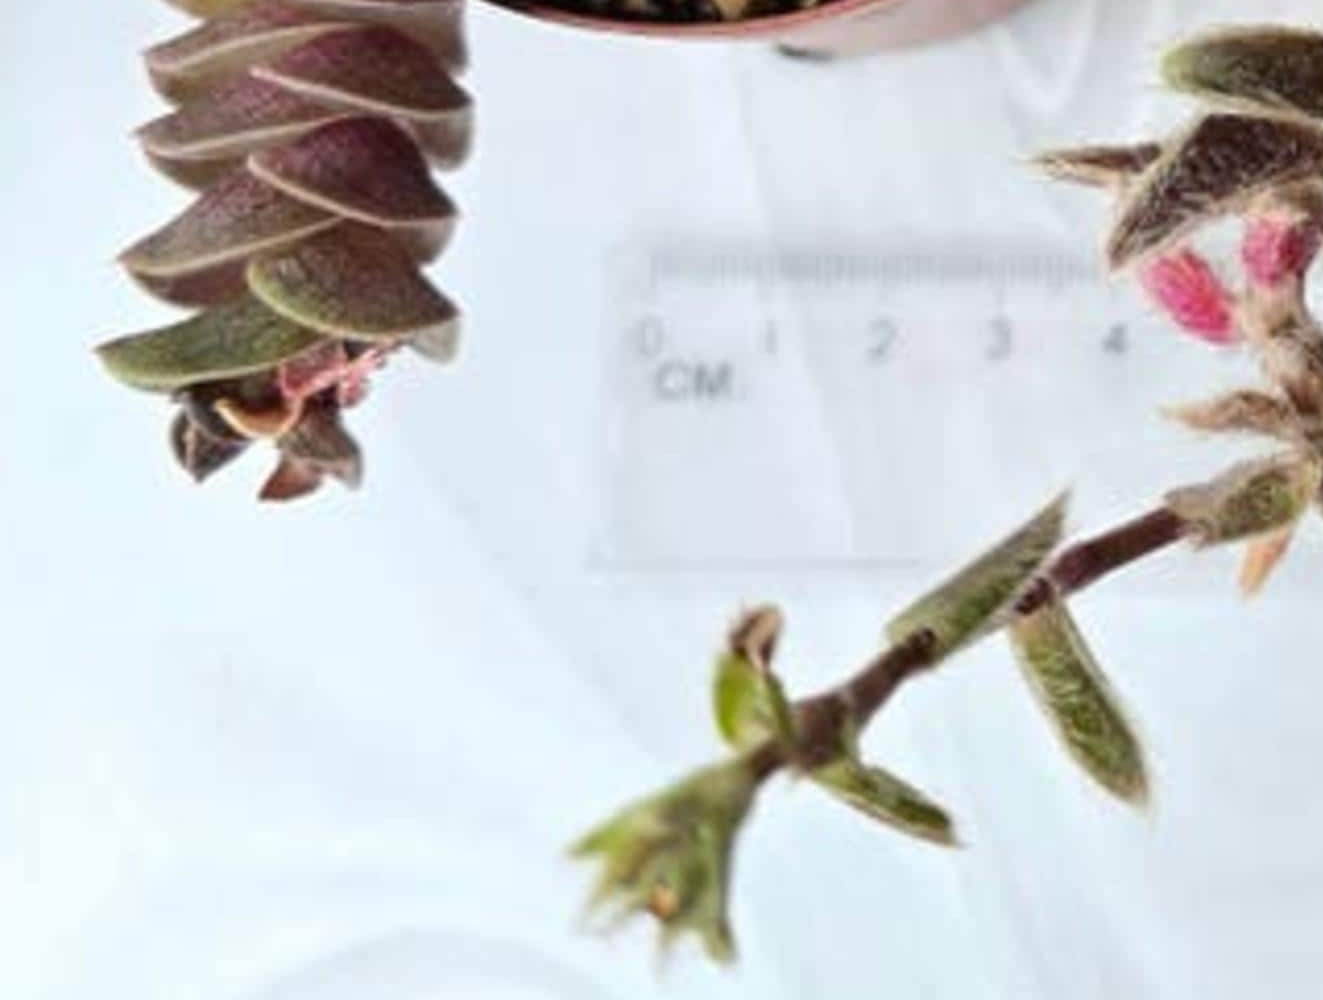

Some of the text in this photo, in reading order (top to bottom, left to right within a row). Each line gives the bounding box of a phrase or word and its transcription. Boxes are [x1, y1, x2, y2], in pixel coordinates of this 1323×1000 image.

[637, 316, 664, 358] 0
[867, 316, 898, 363] 2
[985, 315, 1012, 360] 3
[1101, 320, 1128, 356] 4
[655, 358, 733, 399] CM
